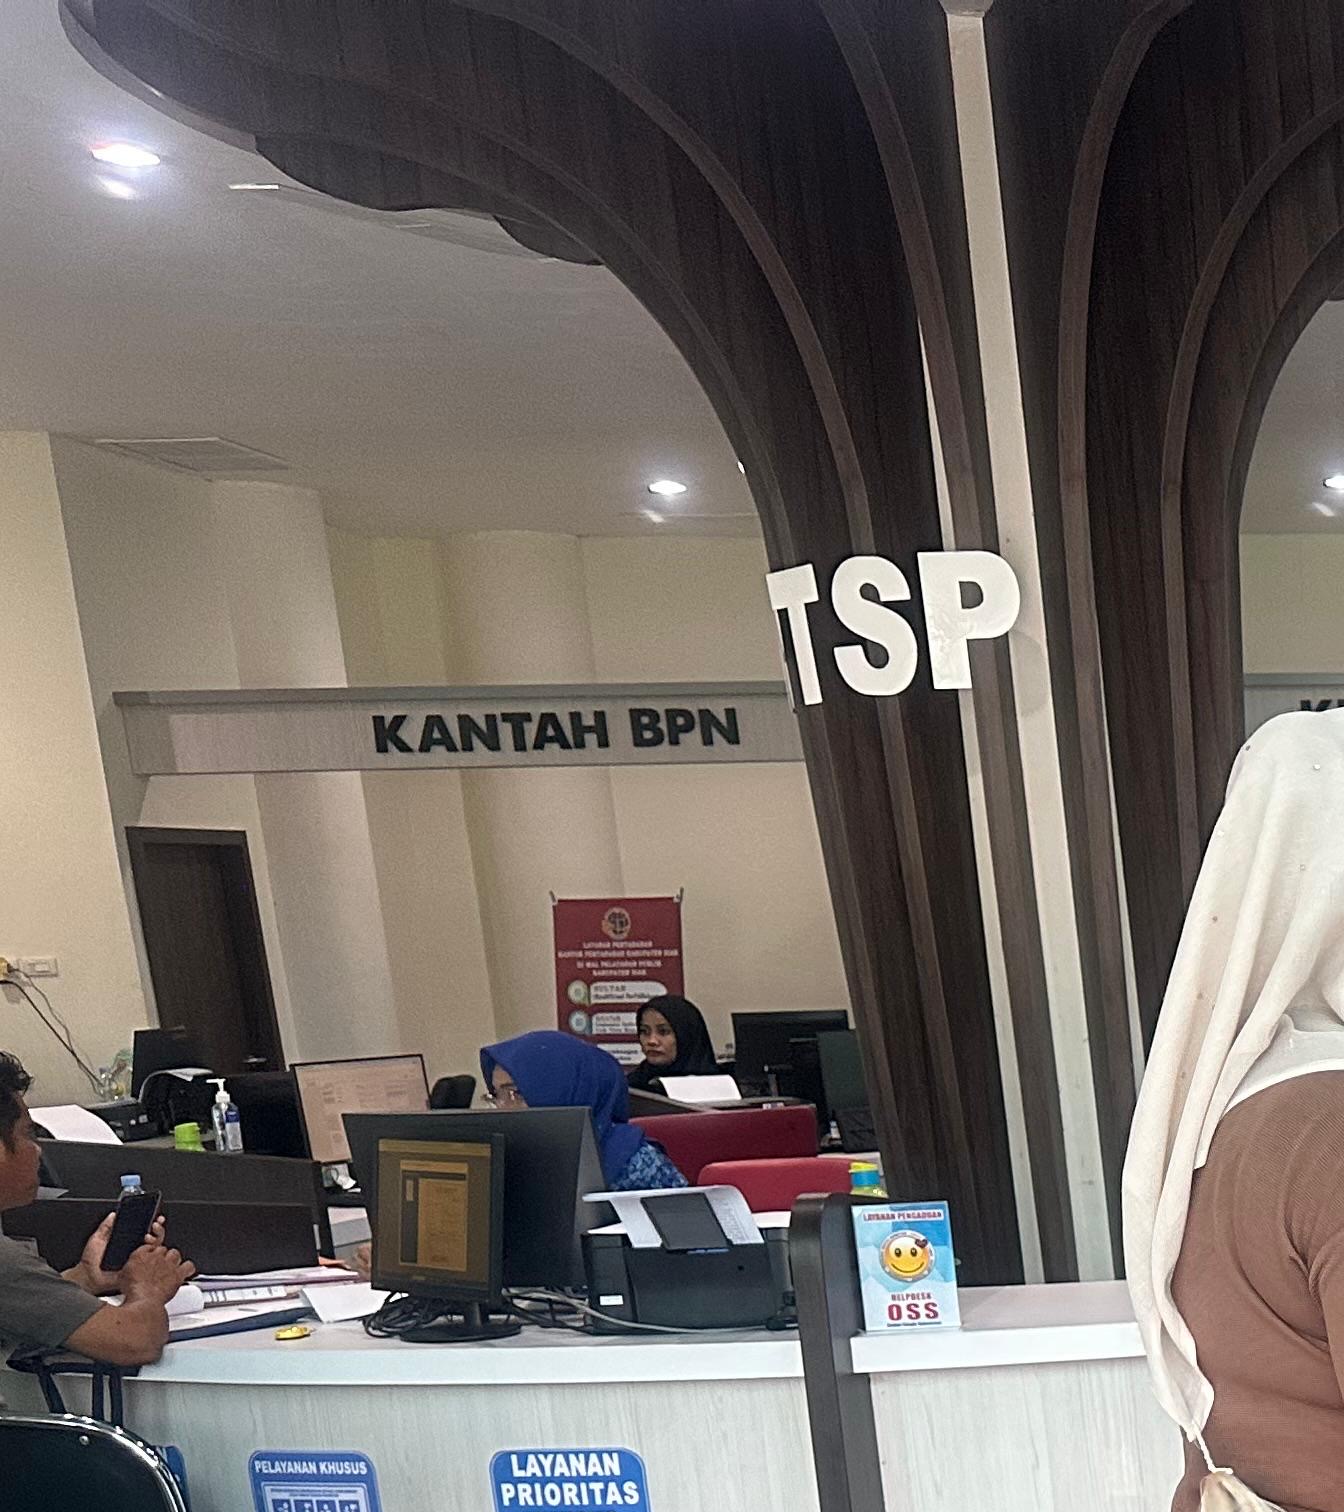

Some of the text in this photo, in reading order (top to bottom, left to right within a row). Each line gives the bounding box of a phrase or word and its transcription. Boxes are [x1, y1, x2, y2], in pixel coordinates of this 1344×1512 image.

[766, 550, 1020, 705] TSP
[372, 707, 740, 753] KANTAH BPN
[888, 1302, 939, 1321] OSS
[254, 1460, 368, 1475] PELAYANAN KHUSUS
[510, 1453, 621, 1477] LAYANAN
[500, 1481, 640, 1506] PRIORITAS
